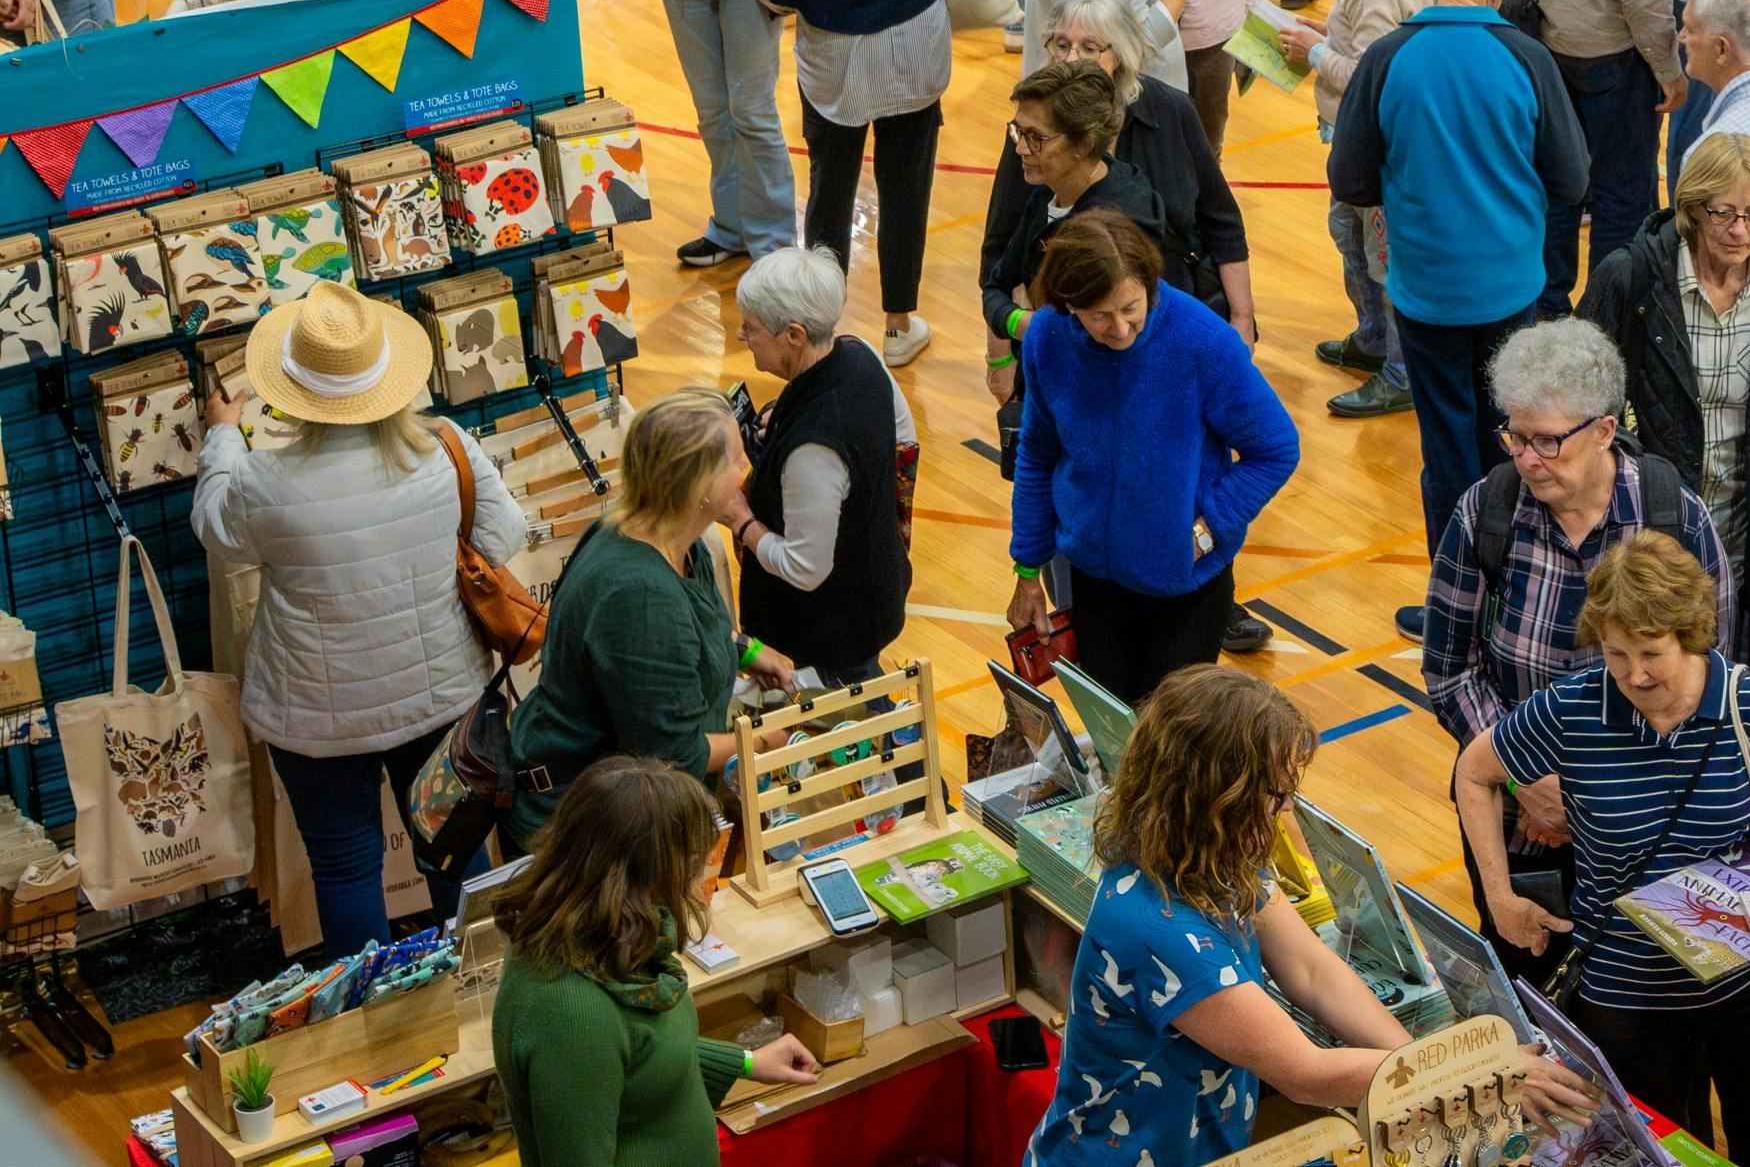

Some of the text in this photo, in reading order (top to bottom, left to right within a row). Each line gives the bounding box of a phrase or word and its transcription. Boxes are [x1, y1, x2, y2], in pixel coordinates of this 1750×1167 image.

[409, 80, 519, 112] TEA TOWELS & TOTE BAGS
[71, 159, 191, 194] TEA TOWELS & TOTE BAGS
[124, 180, 152, 192] RECYCLED
[141, 836, 202, 867] TASMANIA
[1677, 875, 1742, 912] ANIMAL
[1416, 1020, 1499, 1073] RED PARKA
